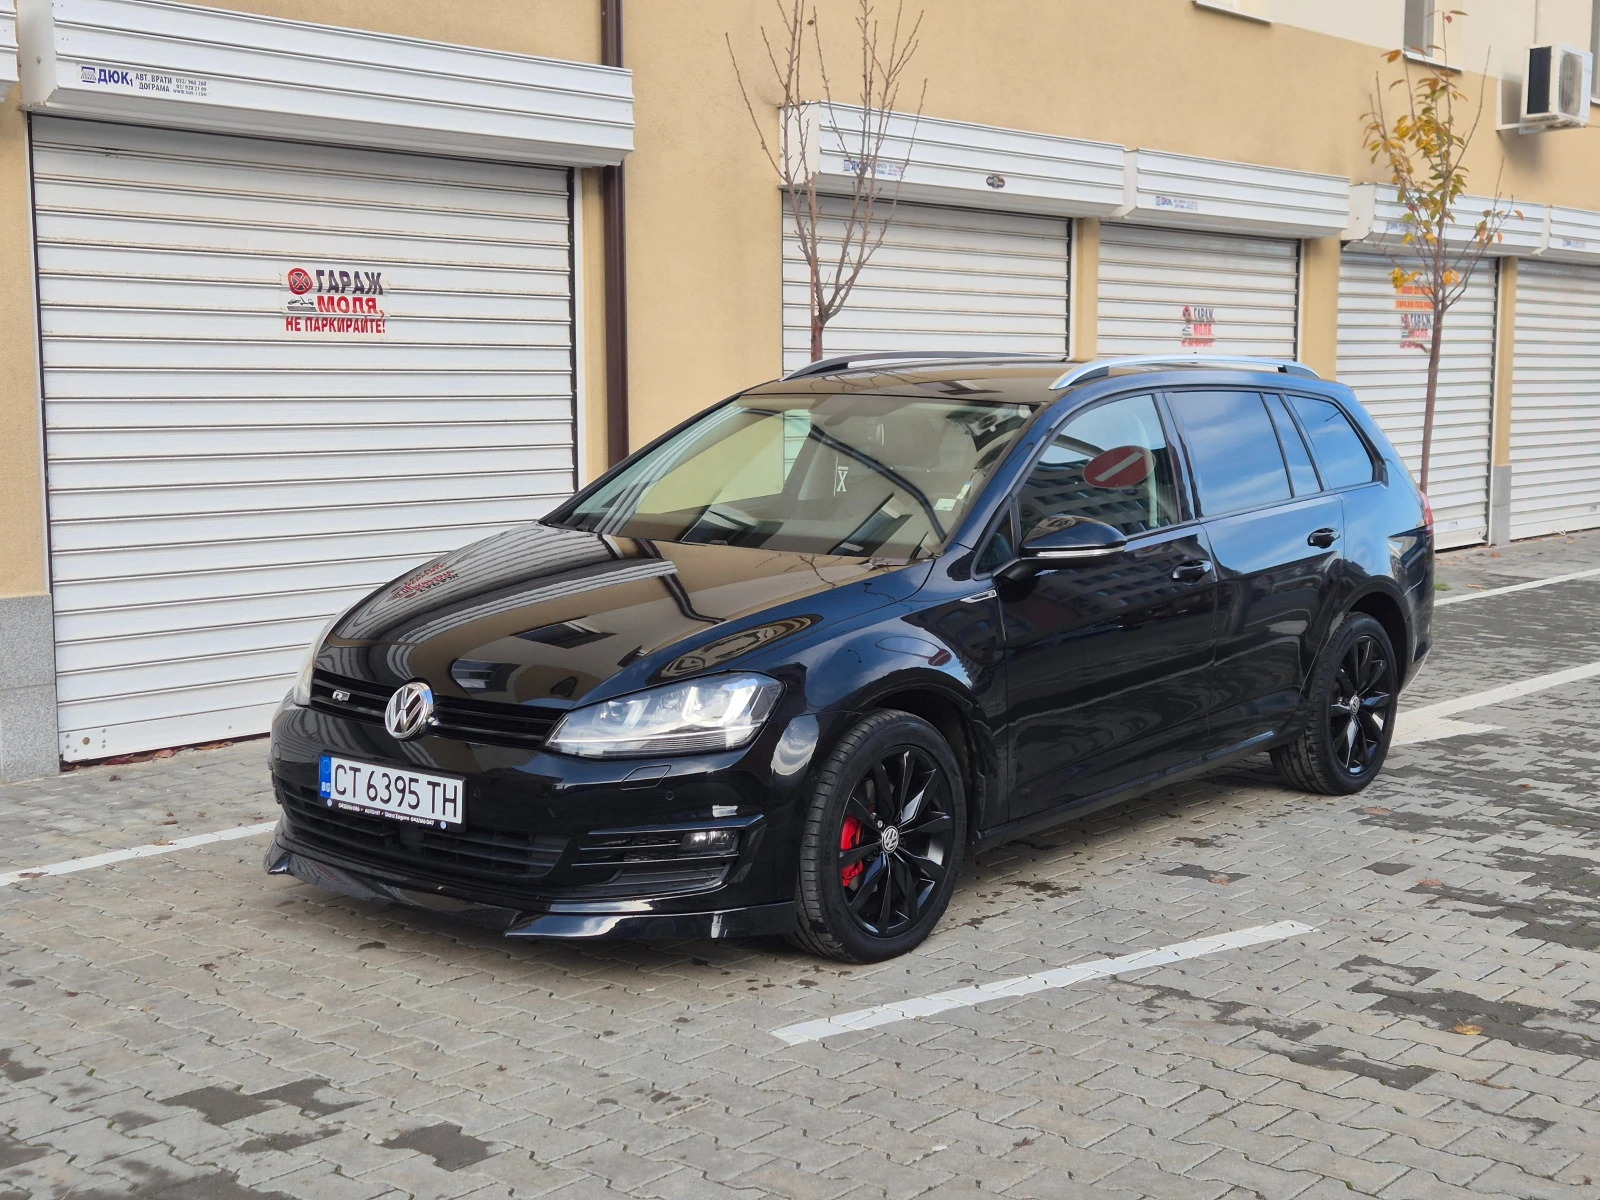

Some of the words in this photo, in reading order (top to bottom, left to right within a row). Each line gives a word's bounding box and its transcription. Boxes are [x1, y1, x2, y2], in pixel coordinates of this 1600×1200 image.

[138, 82, 170, 92] ДОГРАМА
[151, 74, 172, 84] ВРАТИ
[315, 269, 384, 295] ГАРАЖ
[316, 295, 385, 318] МОЛЯ,
[285, 315, 302, 332] НЕ
[304, 315, 386, 334] ПАРКИРАЙТЕ!
[321, 781, 331, 793] BG
[334, 764, 362, 799] CT
[366, 770, 421, 810] 6395
[426, 780, 458, 818] TH
